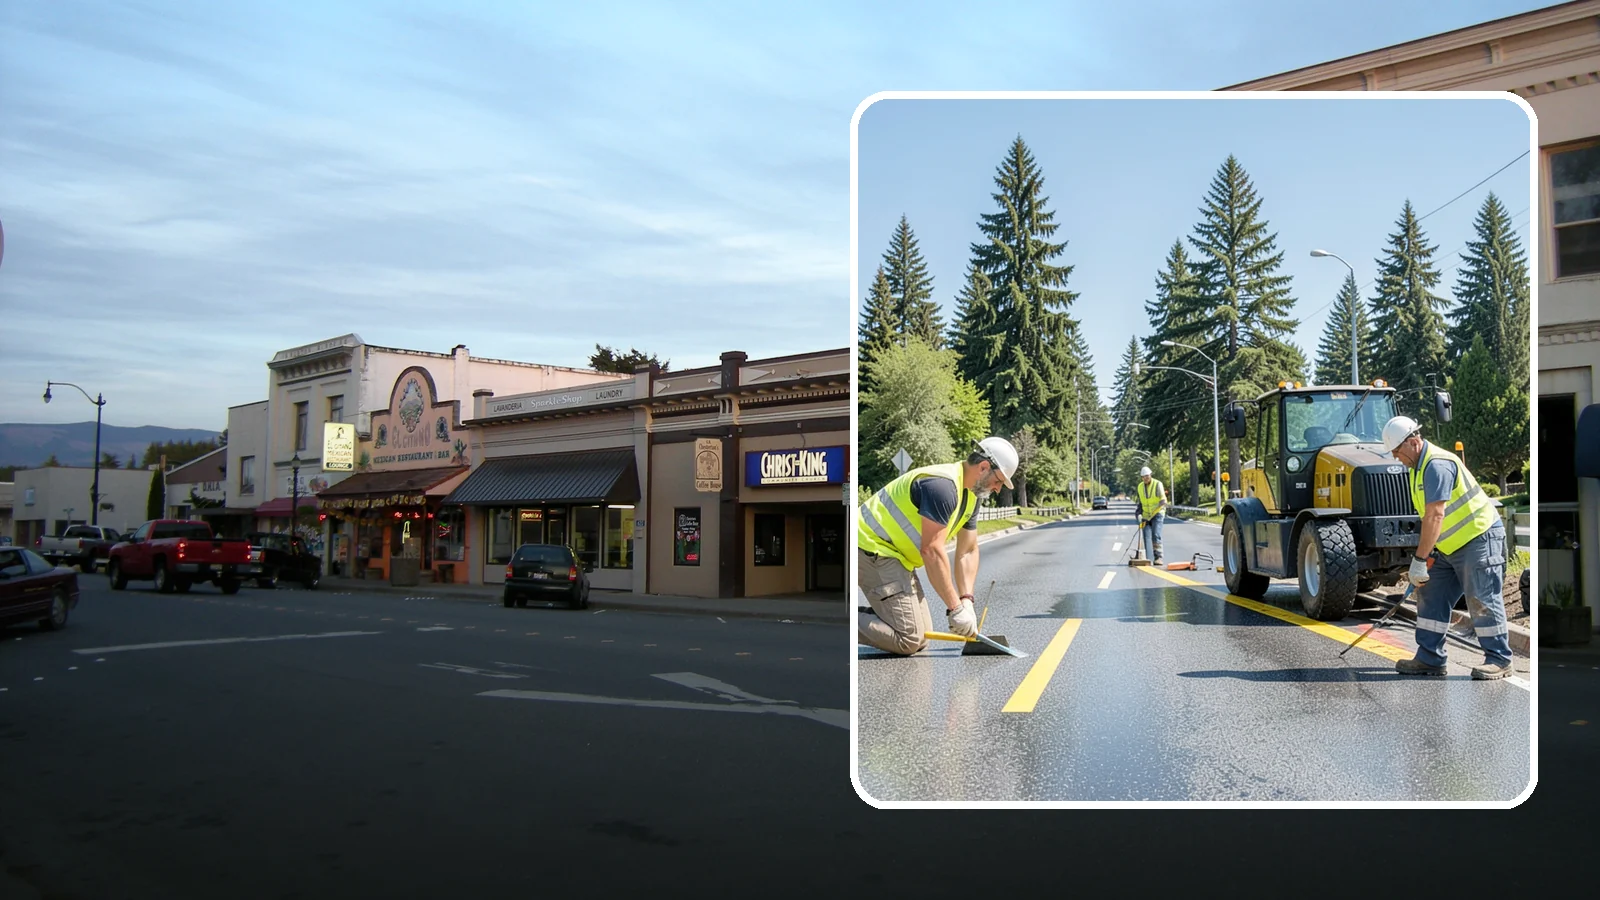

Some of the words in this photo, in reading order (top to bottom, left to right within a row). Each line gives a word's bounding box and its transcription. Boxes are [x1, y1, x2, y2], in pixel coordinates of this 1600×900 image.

[530, 397, 560, 408] Sparkle
[562, 394, 582, 404] Shop
[596, 389, 623, 400] LAUNDRY
[494, 402, 522, 412] LAVANDERIA
[374, 454, 396, 464] MEXICAN
[398, 451, 434, 462] RESTAURANT
[438, 450, 450, 459] BAR
[761, 452, 797, 478] CHRIST
[800, 450, 827, 476] KING
